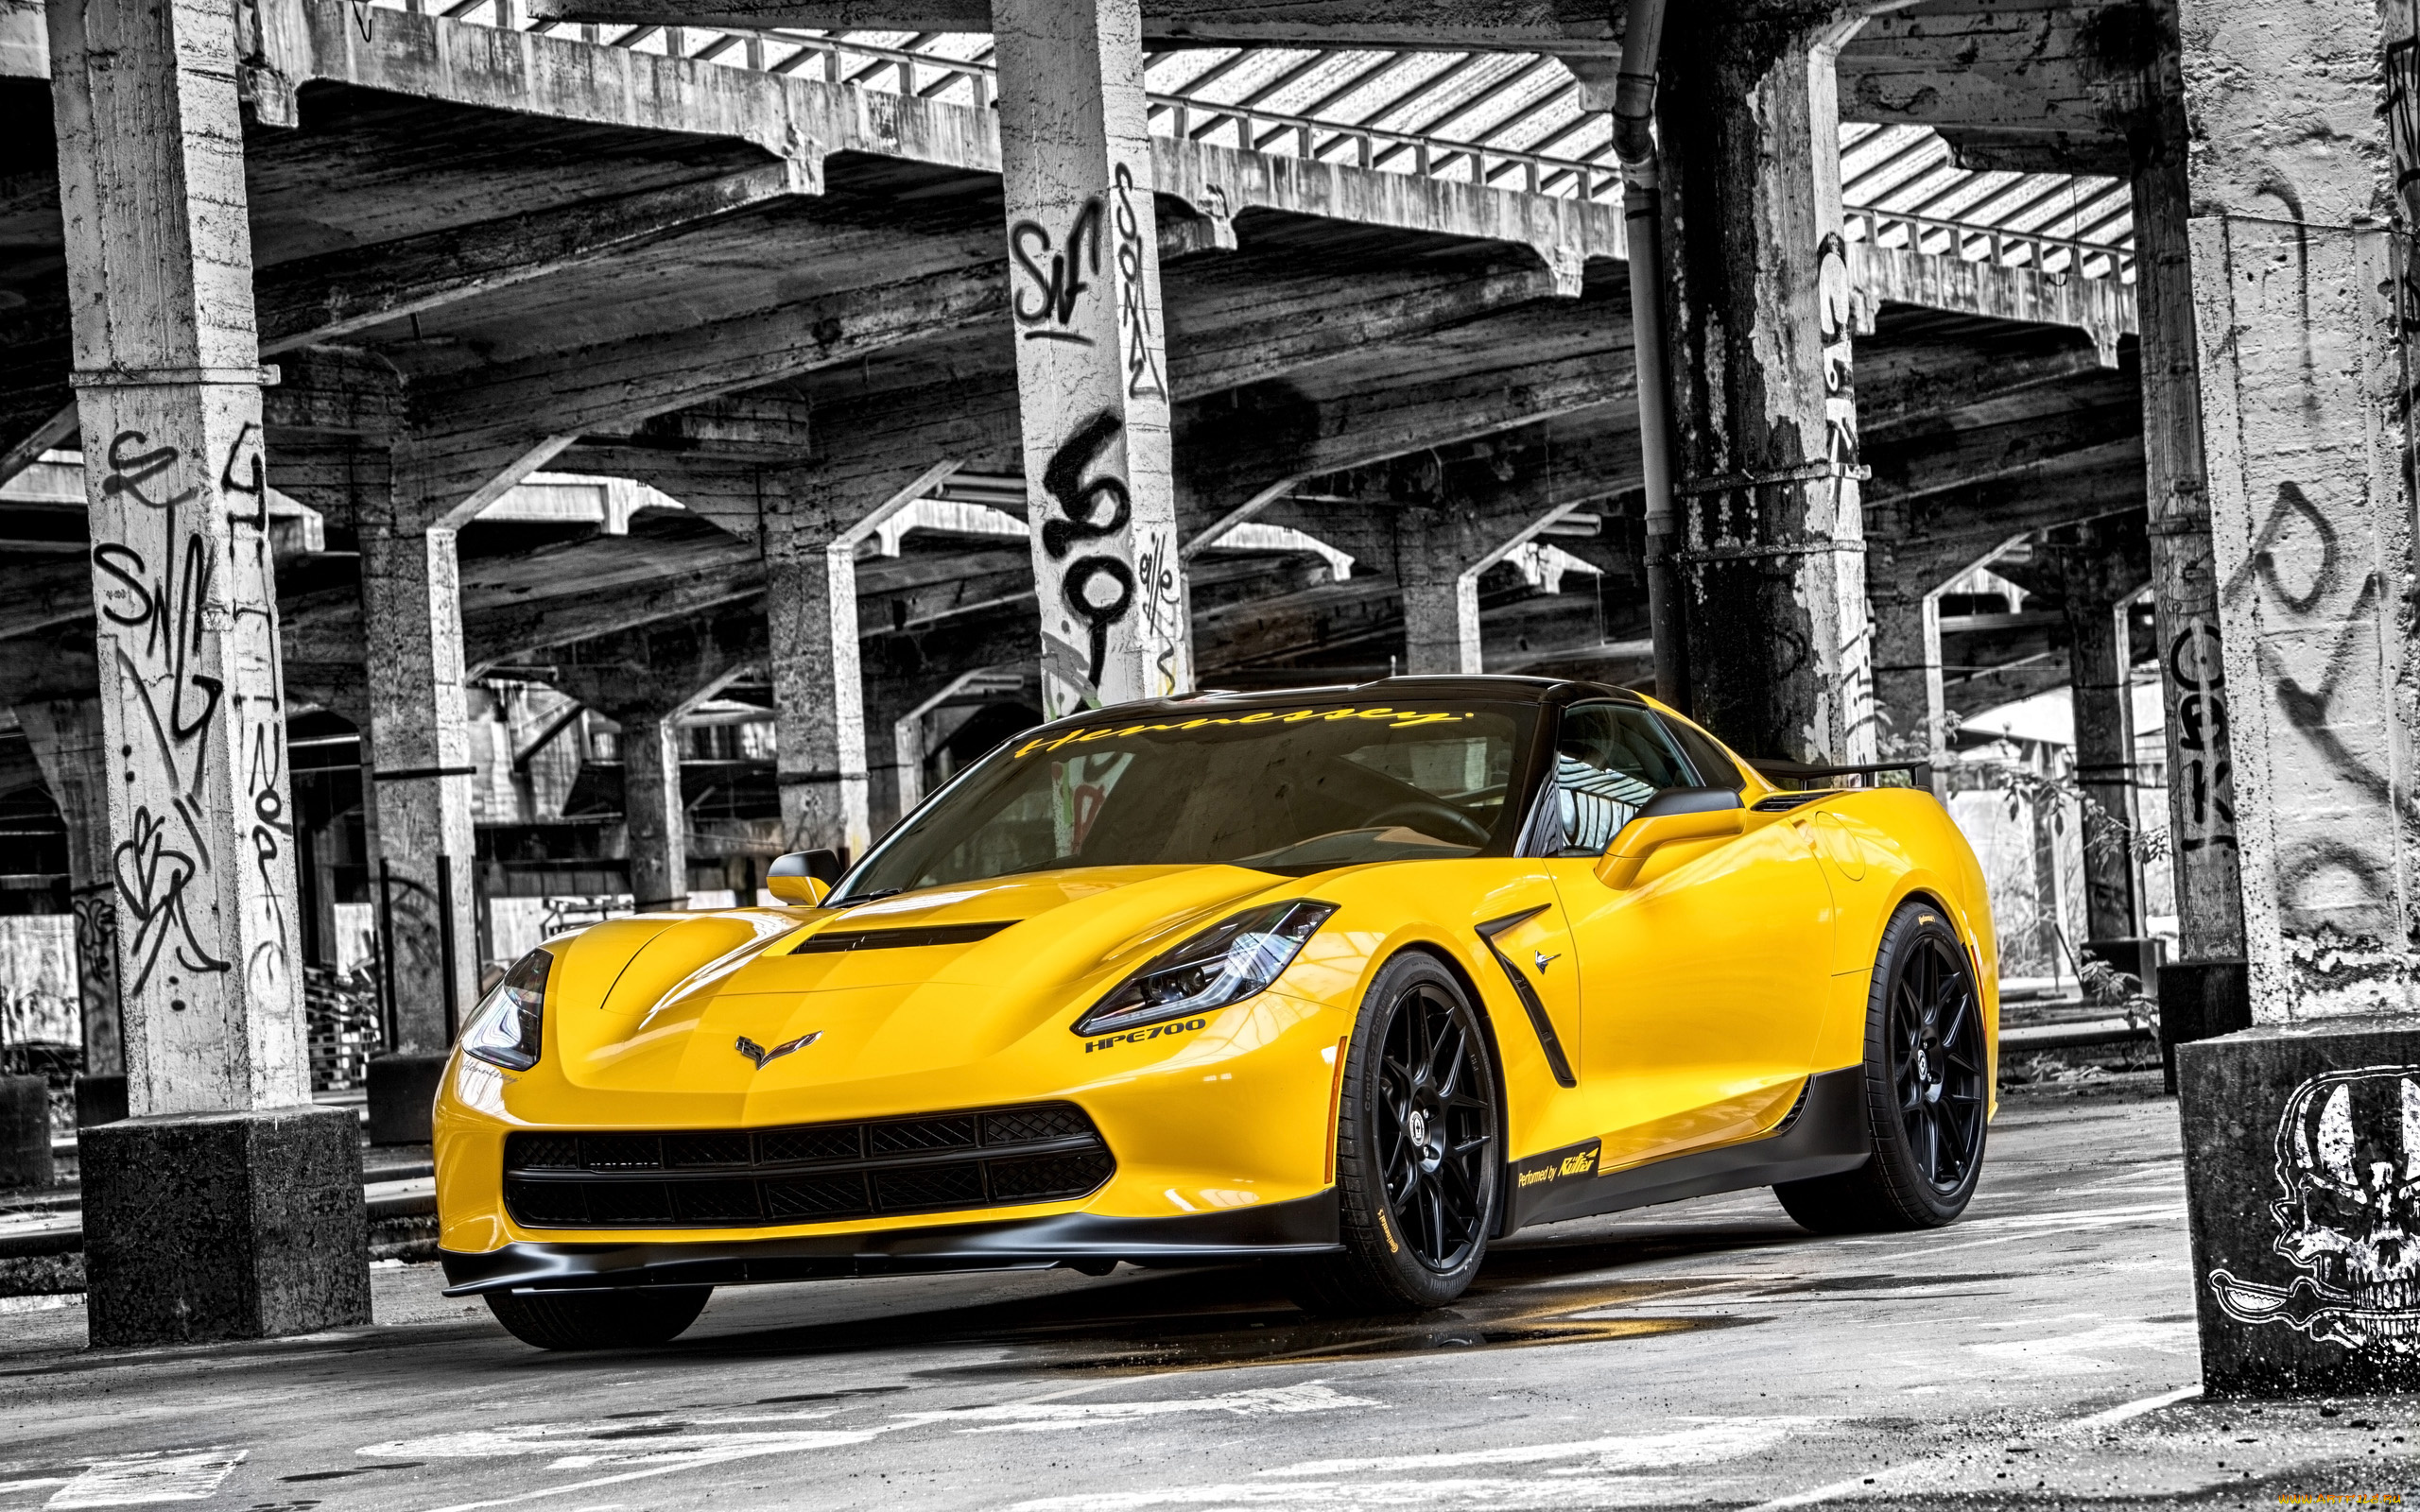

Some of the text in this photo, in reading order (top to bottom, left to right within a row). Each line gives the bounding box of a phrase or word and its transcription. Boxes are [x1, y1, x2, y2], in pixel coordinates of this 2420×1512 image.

[1014, 707, 1464, 759] Hennessey
[1085, 1018, 1206, 1054] HPE700
[1518, 1165, 1549, 1188] Performed
[1547, 1164, 1558, 1182] by
